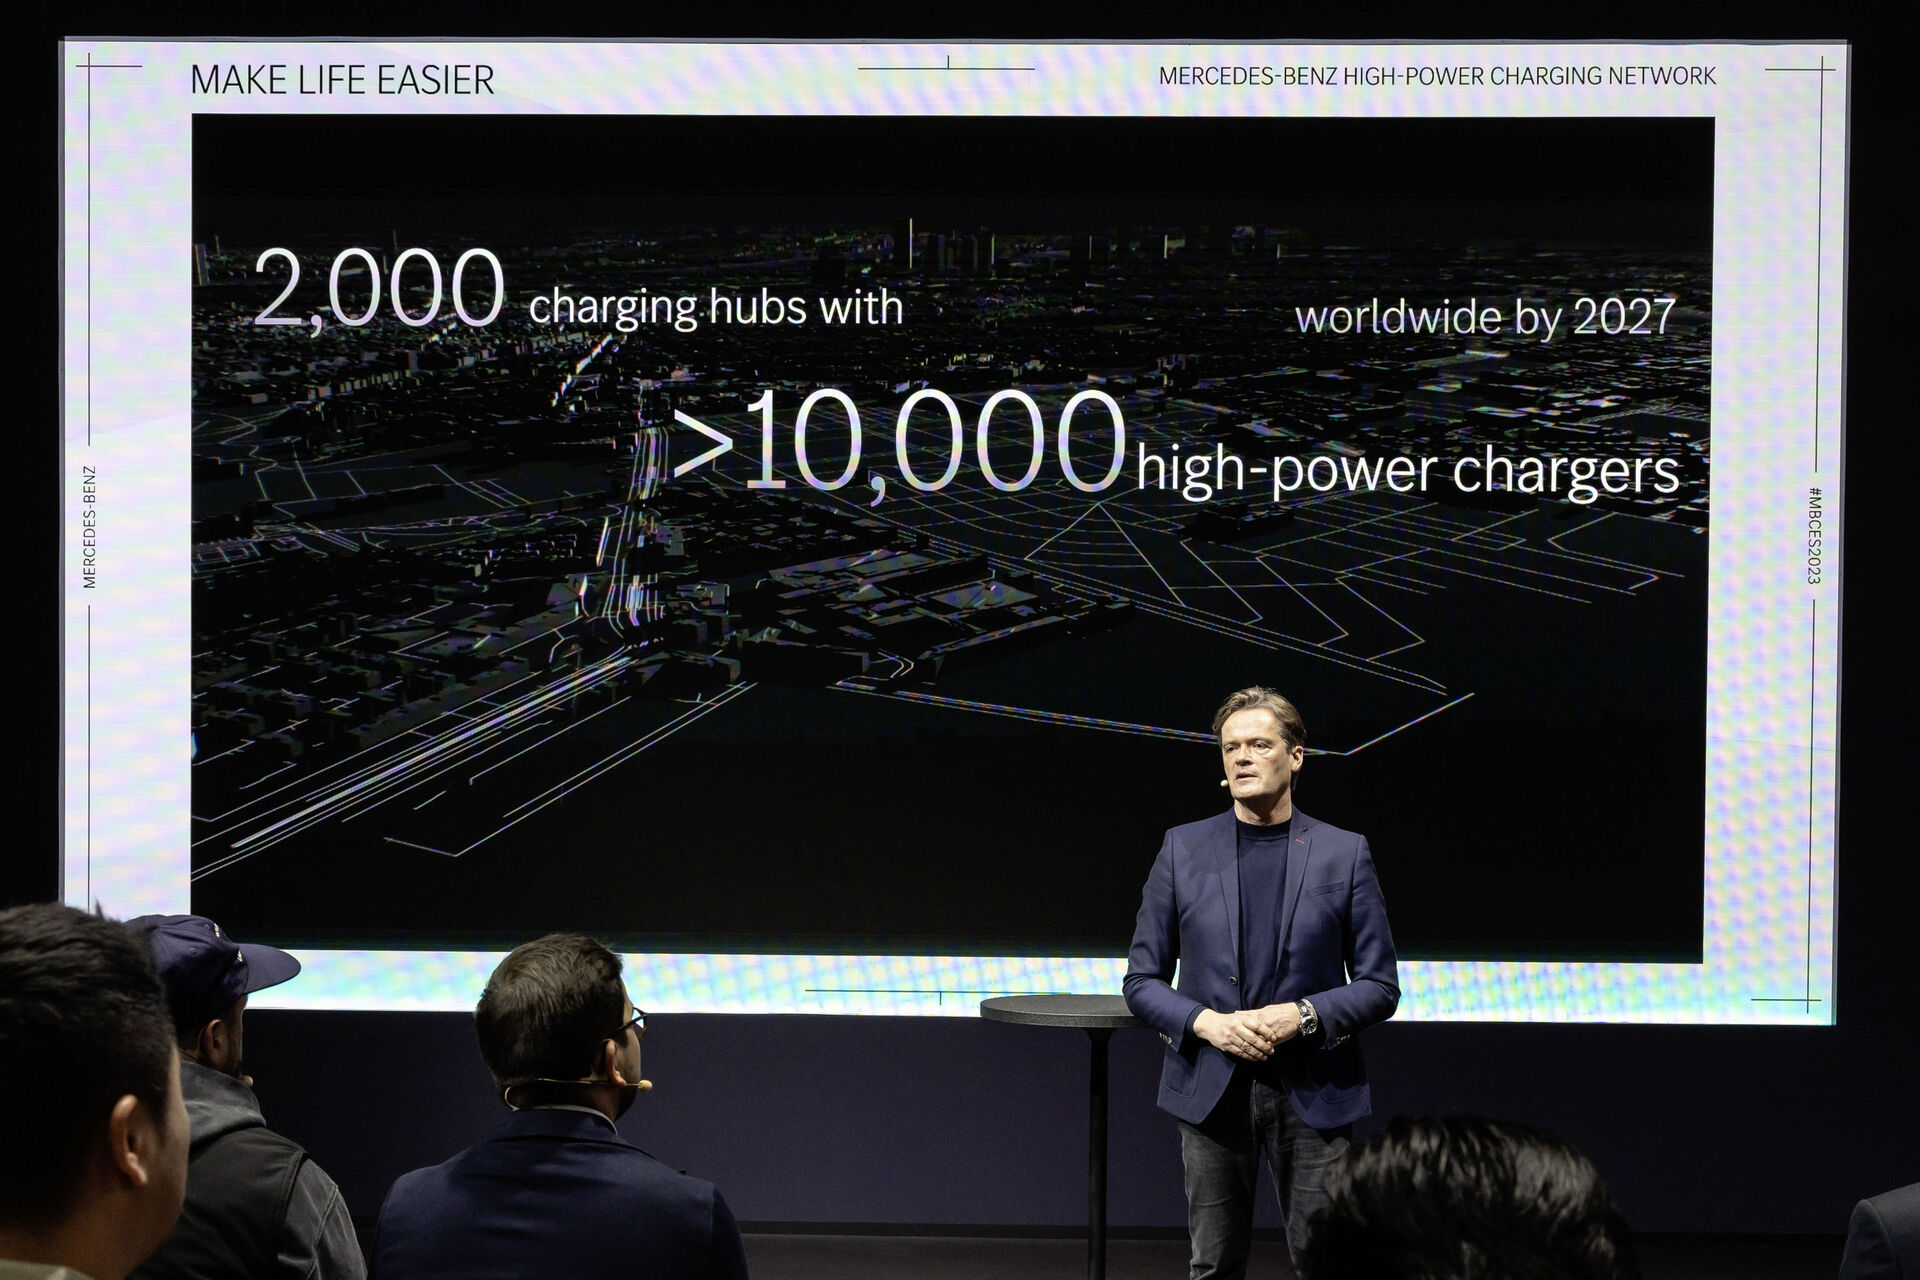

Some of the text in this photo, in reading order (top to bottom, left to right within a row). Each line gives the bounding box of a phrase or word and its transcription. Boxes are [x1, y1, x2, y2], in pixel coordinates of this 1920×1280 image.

[192, 64, 495, 95] MAKE LIFE EASIER
[1160, 66, 1717, 86] MERCEDES-BENZ HIGH-POWER CHARGING NETWORK
[254, 247, 903, 339] 2,000 charging hubs with
[1295, 297, 1676, 343] worldwide by 2027
[673, 387, 1680, 507] >10,000 high-power chargers
[82, 466, 96, 589] MERCEDES-BENZ
[1807, 487, 1822, 585] #MBCES2023
